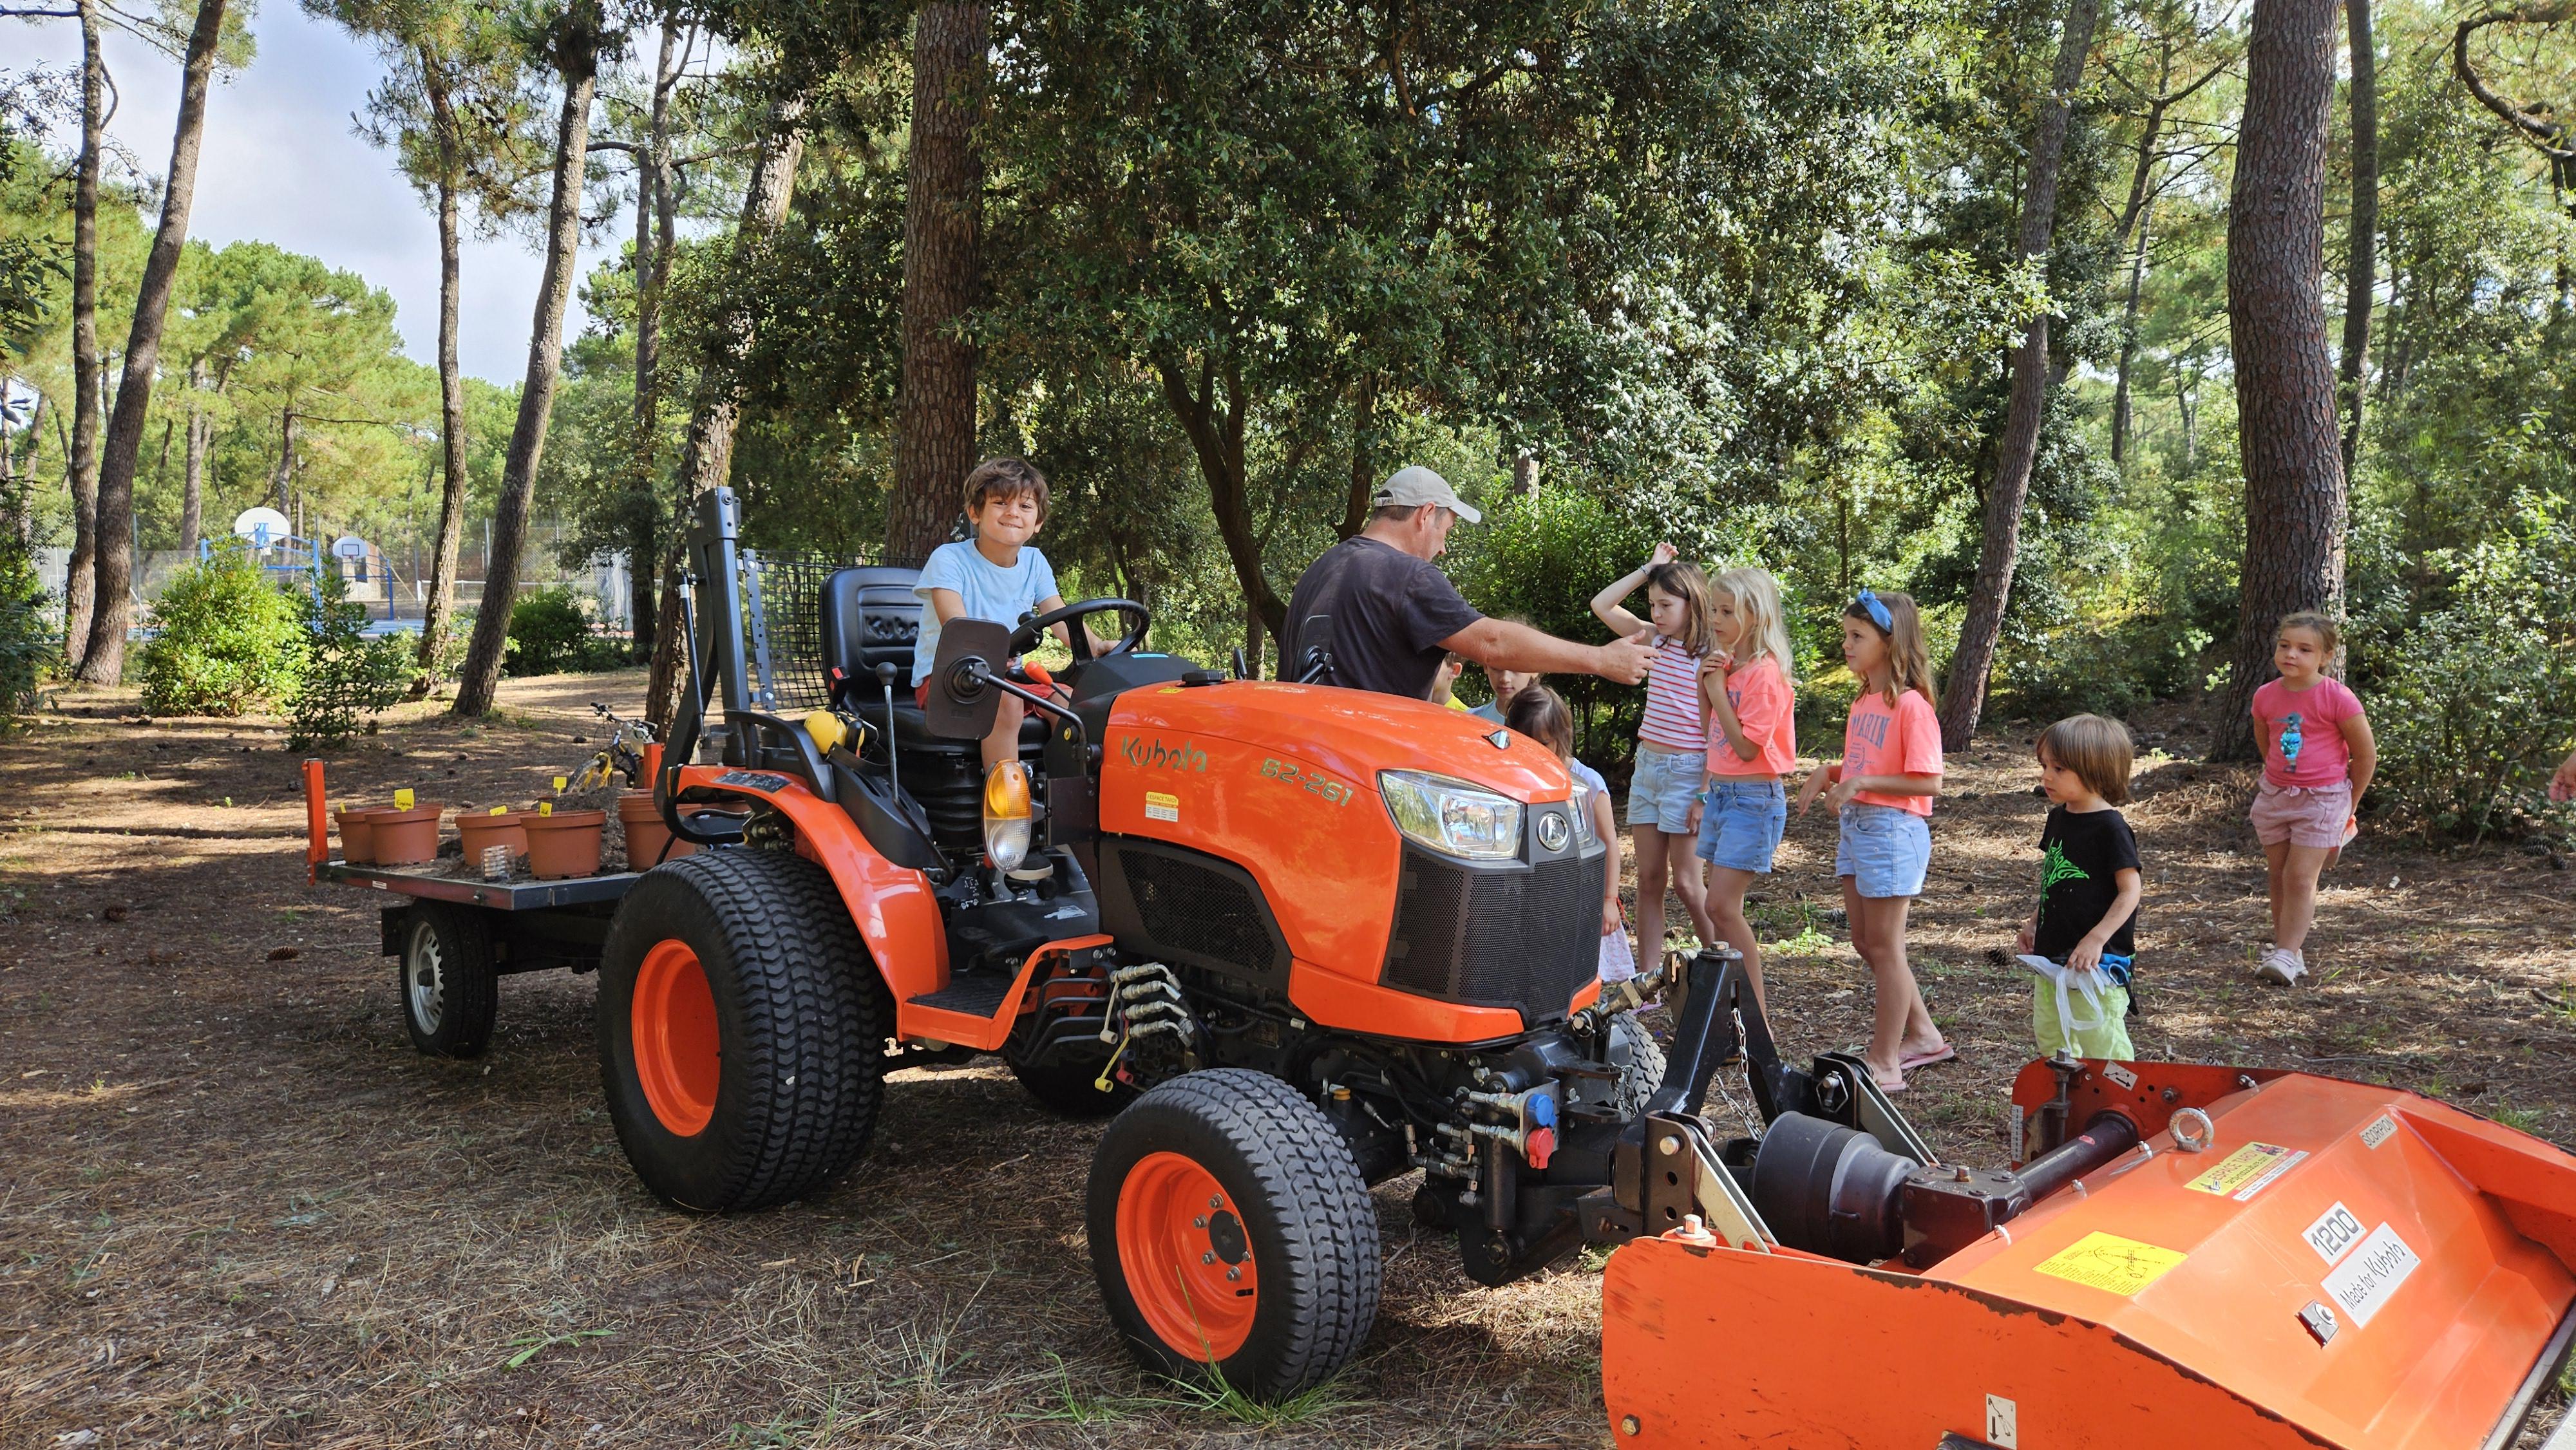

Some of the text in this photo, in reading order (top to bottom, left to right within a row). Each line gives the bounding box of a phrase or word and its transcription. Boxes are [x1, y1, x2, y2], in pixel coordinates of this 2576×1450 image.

[864, 615, 920, 639] Kubo
[1121, 735, 1208, 773] Kubota
[1260, 757, 1354, 807] B2-261
[2362, 1116, 2395, 1146] SCORPION
[2207, 1162, 2243, 1180] ESPACE
[2311, 1208, 2360, 1256] 1200
[2340, 1241, 2407, 1310] Made for Kubota
